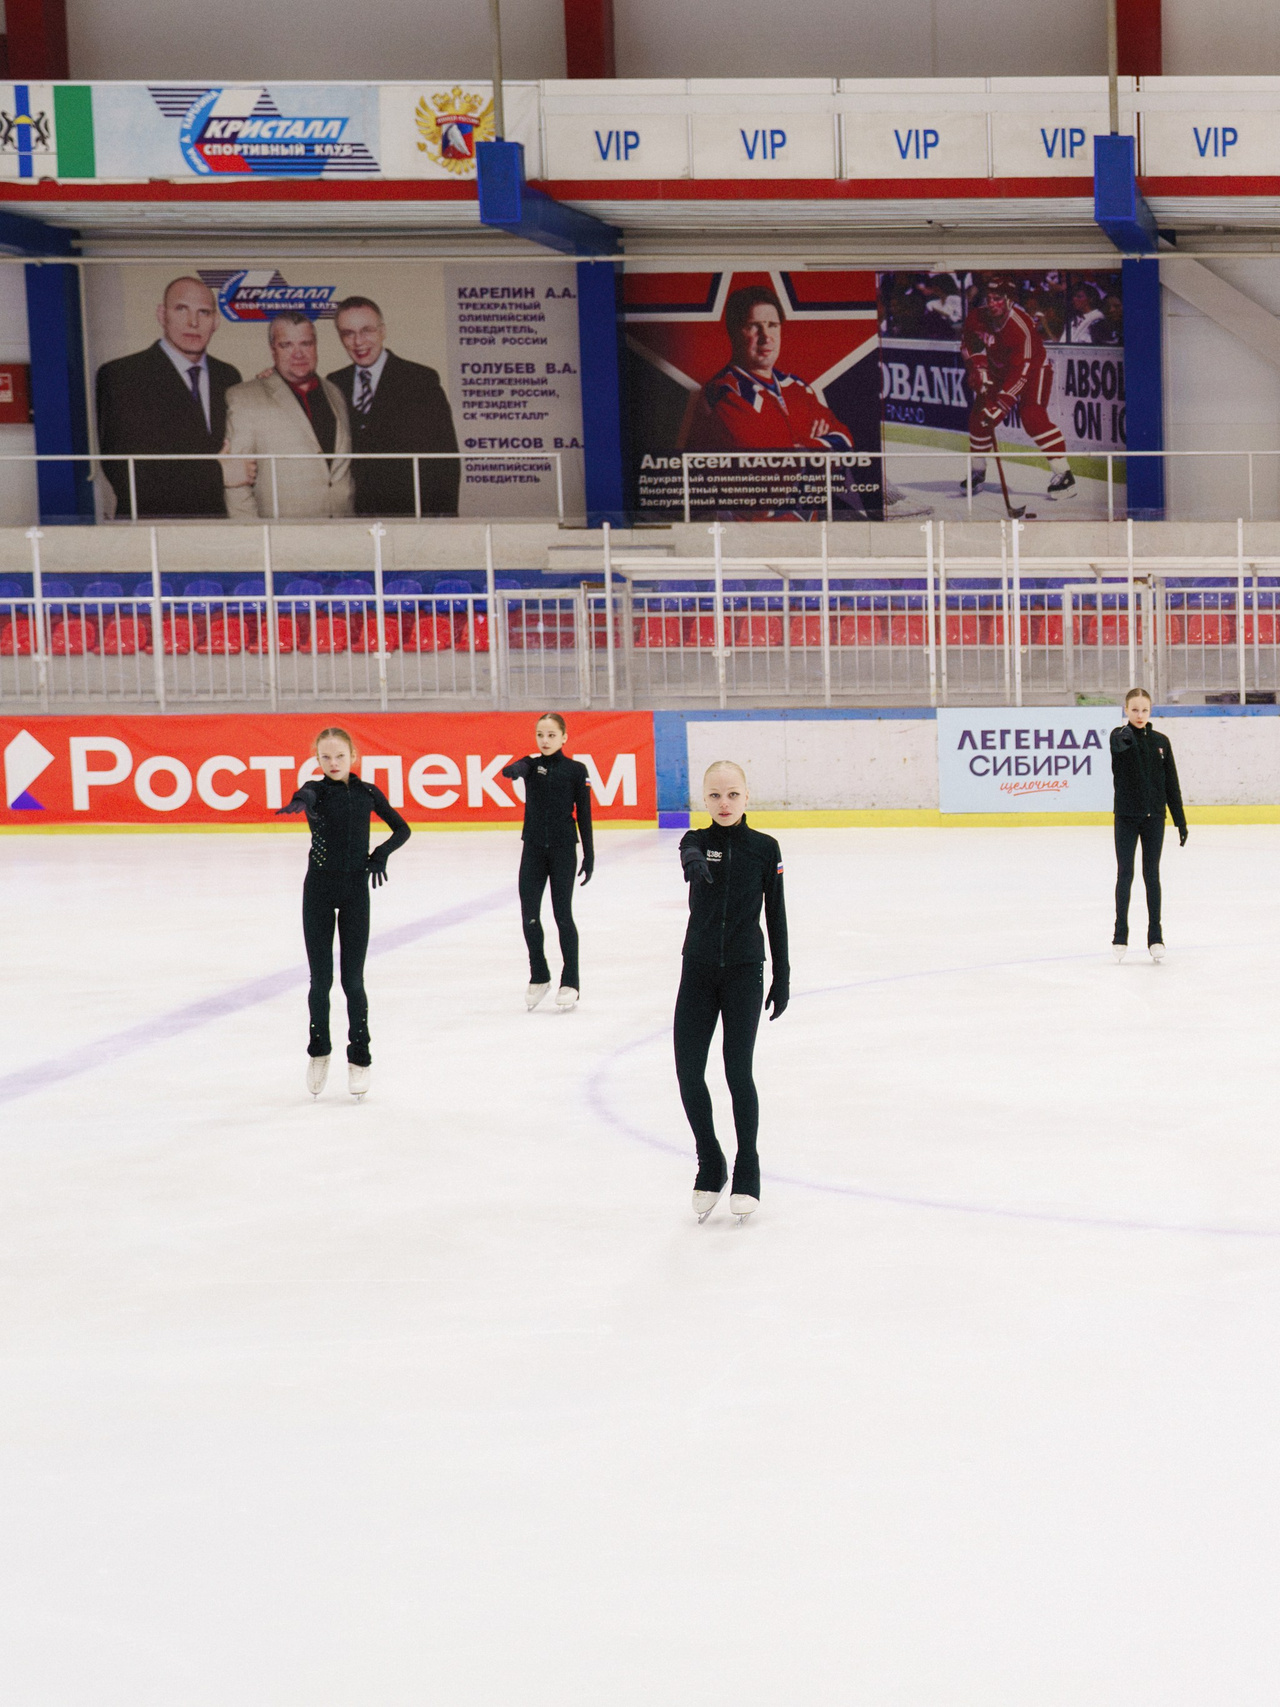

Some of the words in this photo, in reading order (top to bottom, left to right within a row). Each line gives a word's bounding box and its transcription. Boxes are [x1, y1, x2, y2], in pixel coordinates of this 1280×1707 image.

[203, 119, 343, 139] КРИСТАЛЛ
[595, 130, 640, 161] VIP
[740, 129, 786, 160] VIP
[894, 129, 939, 160] VIP
[1041, 128, 1086, 158] VIP
[1194, 127, 1238, 157] VIP
[202, 143, 305, 157] СПОРТИВНЫЙ
[313, 143, 354, 157] КЛУБ
[235, 288, 330, 300] КРИСТАЛЛ
[458, 287, 535, 299] КАРЕЛИН
[545, 287, 577, 299] А.А.
[458, 301, 541, 310] ТРЕХКРАТНЫЙ
[459, 312, 545, 322] ОЛИМПИЙСКИЙ
[460, 325, 538, 335] ПОБЕДИТЕЛЬ,
[460, 335, 496, 345] ГЕРОЙ
[502, 337, 548, 345] РОССИИ
[461, 363, 536, 374] ГОЛУБЕВ
[545, 363, 577, 374] В.А.
[462, 377, 548, 386] ЗАСЛУЖЕННЫЙ
[462, 389, 504, 397] ТРЕНЕР
[511, 389, 560, 398] РОССИИ,
[463, 400, 528, 409] ПРЕЗИДЕНТ
[463, 412, 477, 420] СК
[1074, 400, 1102, 441] ON
[464, 437, 544, 449] ФЕТИСОВ
[553, 437, 584, 449] В.А.
[466, 462, 552, 472] ОЛИМПИЙСКИЙ
[466, 475, 541, 484] ПОБЕДИТЕЛЬ
[639, 475, 704, 485] Двукратый
[707, 474, 780, 483] олимпийский
[783, 473, 846, 482] победитль
[850, 483, 880, 492] СССР
[718, 498, 757, 506] мастер
[759, 498, 796, 506] спорта
[798, 496, 828, 505] СССР
[957, 729, 1103, 750] ЛЕГЕНДА
[969, 755, 1092, 777] СИБИРИ
[999, 779, 1070, 794] щелочная
